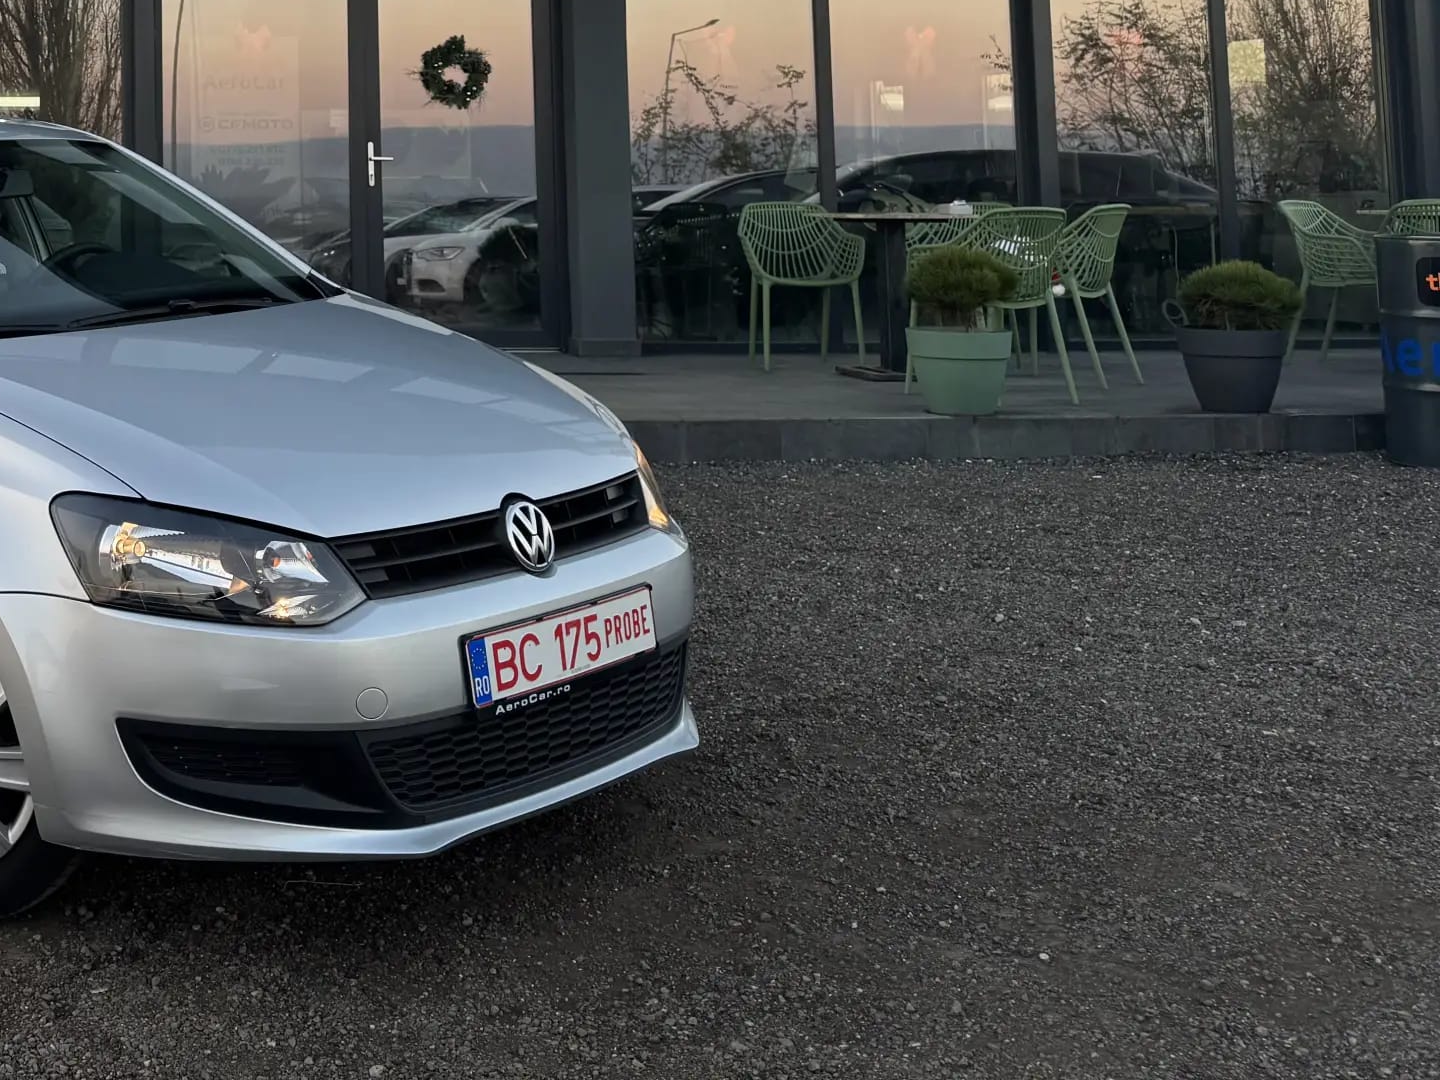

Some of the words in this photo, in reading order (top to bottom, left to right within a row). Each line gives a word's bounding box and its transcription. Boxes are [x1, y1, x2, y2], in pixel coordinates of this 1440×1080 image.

[506, 501, 555, 571] VW
[492, 633, 542, 692] BC
[554, 614, 602, 671] 175
[604, 604, 651, 648] PROBE
[475, 675, 490, 698] RO
[495, 684, 571, 716] AeroCar.ro
